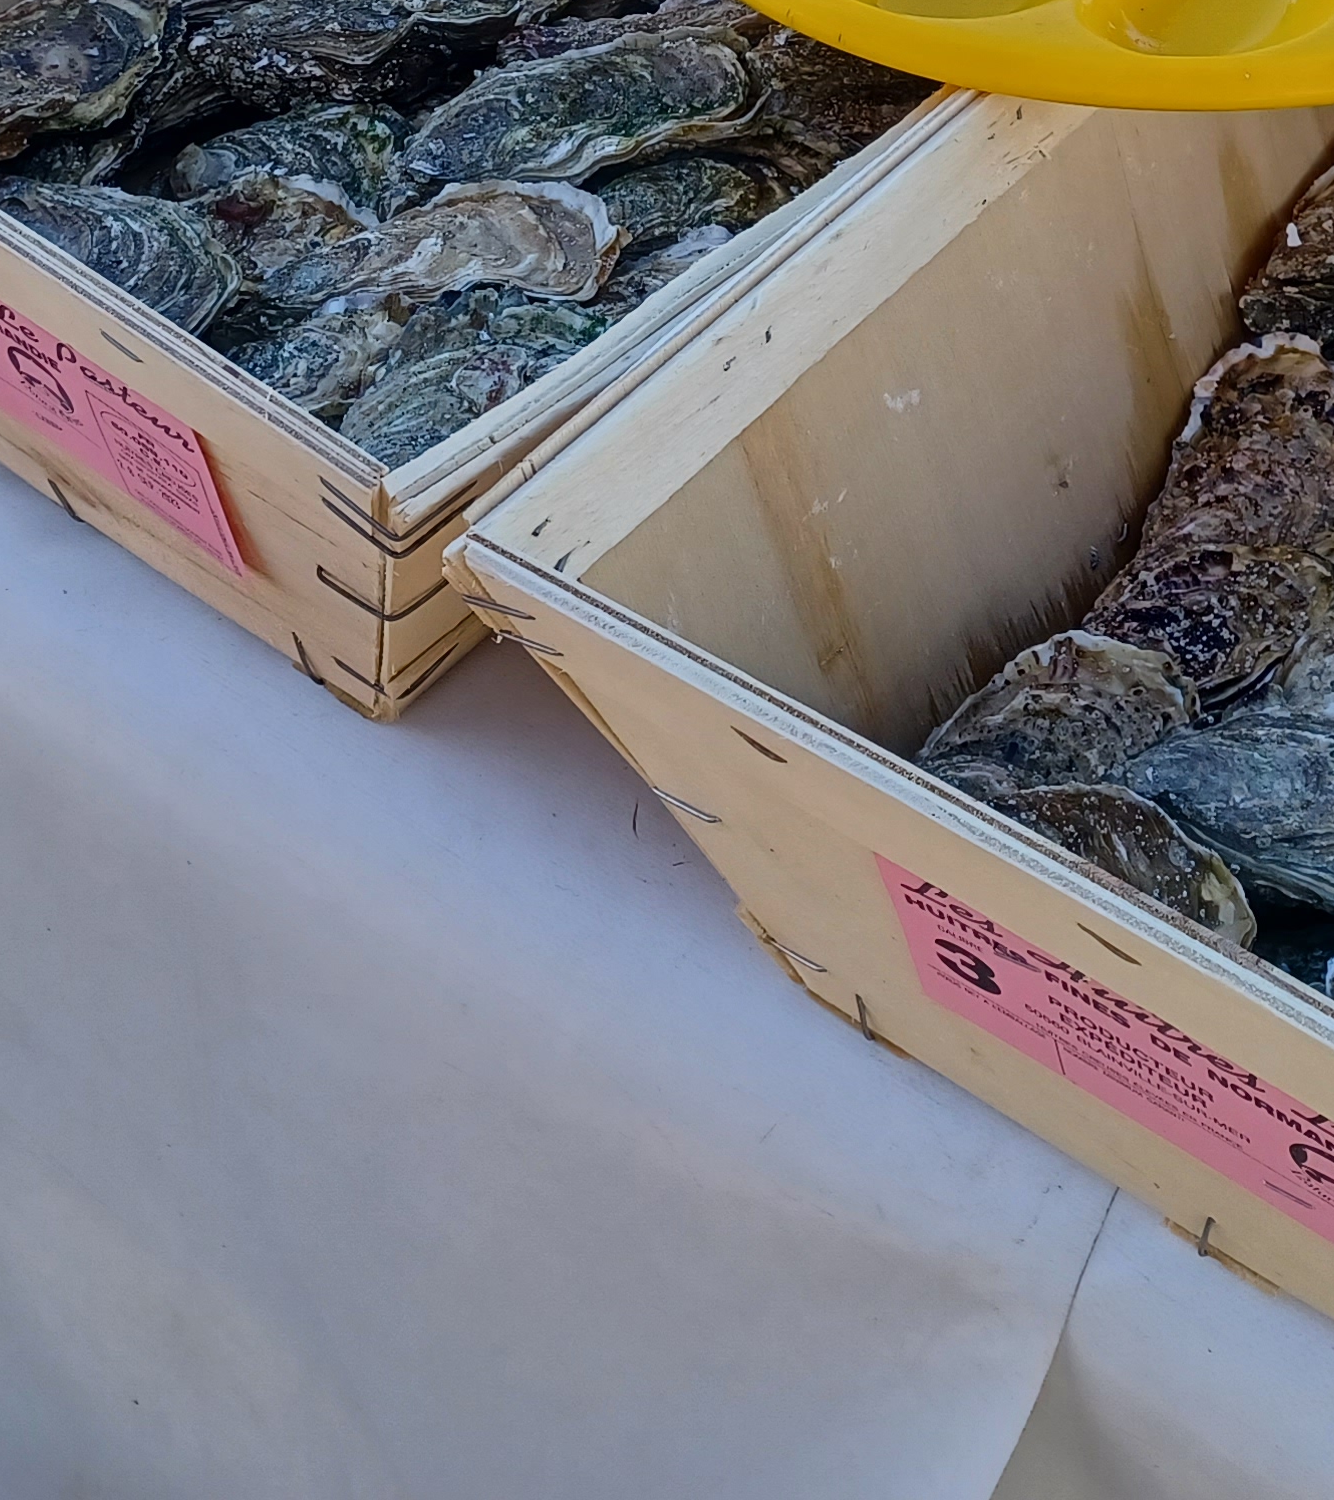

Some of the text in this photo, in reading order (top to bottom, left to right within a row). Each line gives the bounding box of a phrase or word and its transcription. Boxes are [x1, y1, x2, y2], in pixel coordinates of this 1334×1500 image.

[56, 342, 195, 454] Pasteur
[904, 893, 1031, 970] HUITRES
[1044, 969, 1131, 1029] FINES
[1149, 1033, 1193, 1068] DE
[934, 938, 1002, 996] 3
[1047, 994, 1215, 1103] PRODUCTEUR
[1058, 1012, 1208, 1109] EXPÉDITEUR
